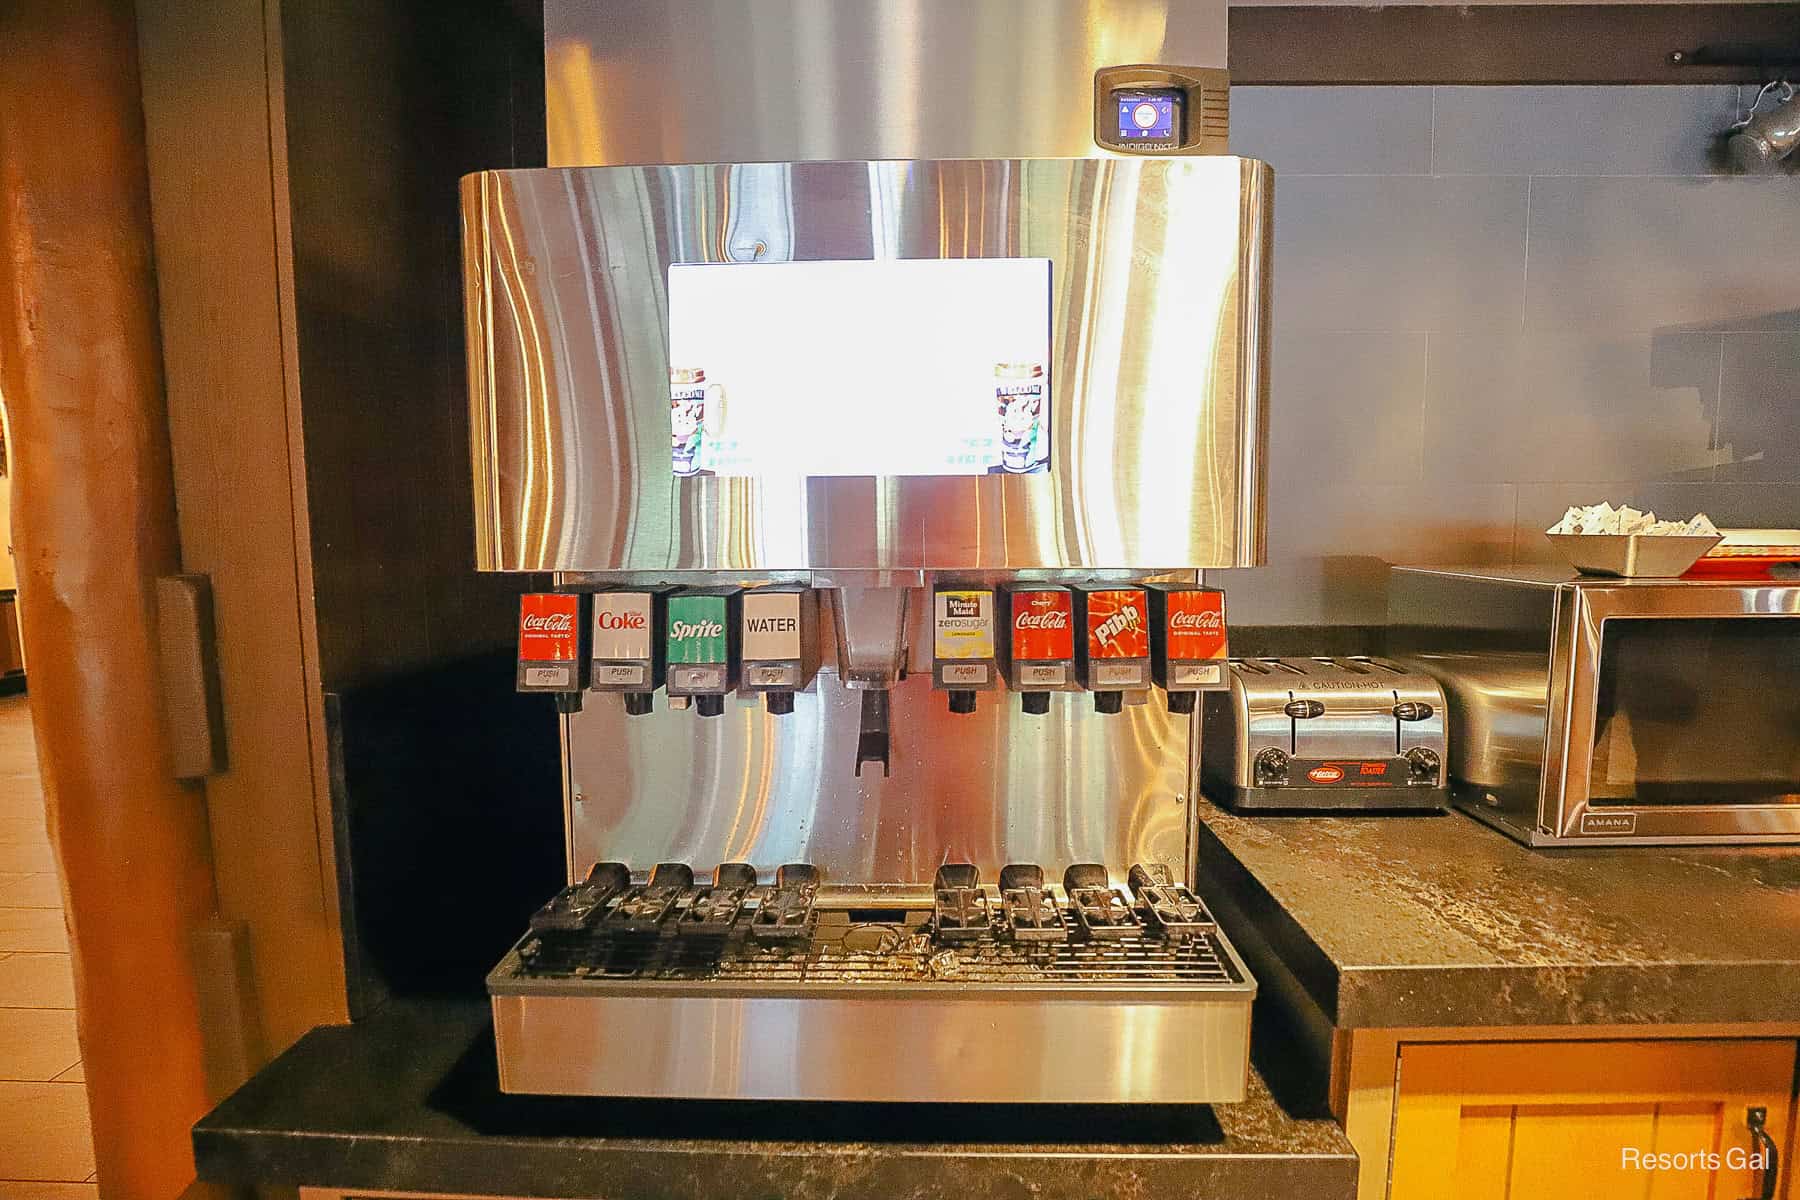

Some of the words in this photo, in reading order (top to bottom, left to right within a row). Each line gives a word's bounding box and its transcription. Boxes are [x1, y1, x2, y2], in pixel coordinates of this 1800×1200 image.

[949, 600, 978, 608] Minute
[953, 608, 974, 616] Maid
[523, 613, 573, 631] Coca-Cola
[599, 611, 646, 630] Coke
[1015, 611, 1067, 629] Coca-Cola
[1170, 610, 1221, 629] Coca-Cola
[747, 618, 796, 632] WATER
[1094, 605, 1138, 646] Pibb
[670, 619, 723, 641] Sprite
[537, 670, 559, 678] PUSH
[611, 668, 633, 676] PUSH
[761, 669, 784, 677] PUSH
[953, 666, 977, 675] PUSH
[1032, 668, 1055, 677] PUSH
[1187, 667, 1210, 675] PUSH
[1588, 818, 1630, 826] AMANA
